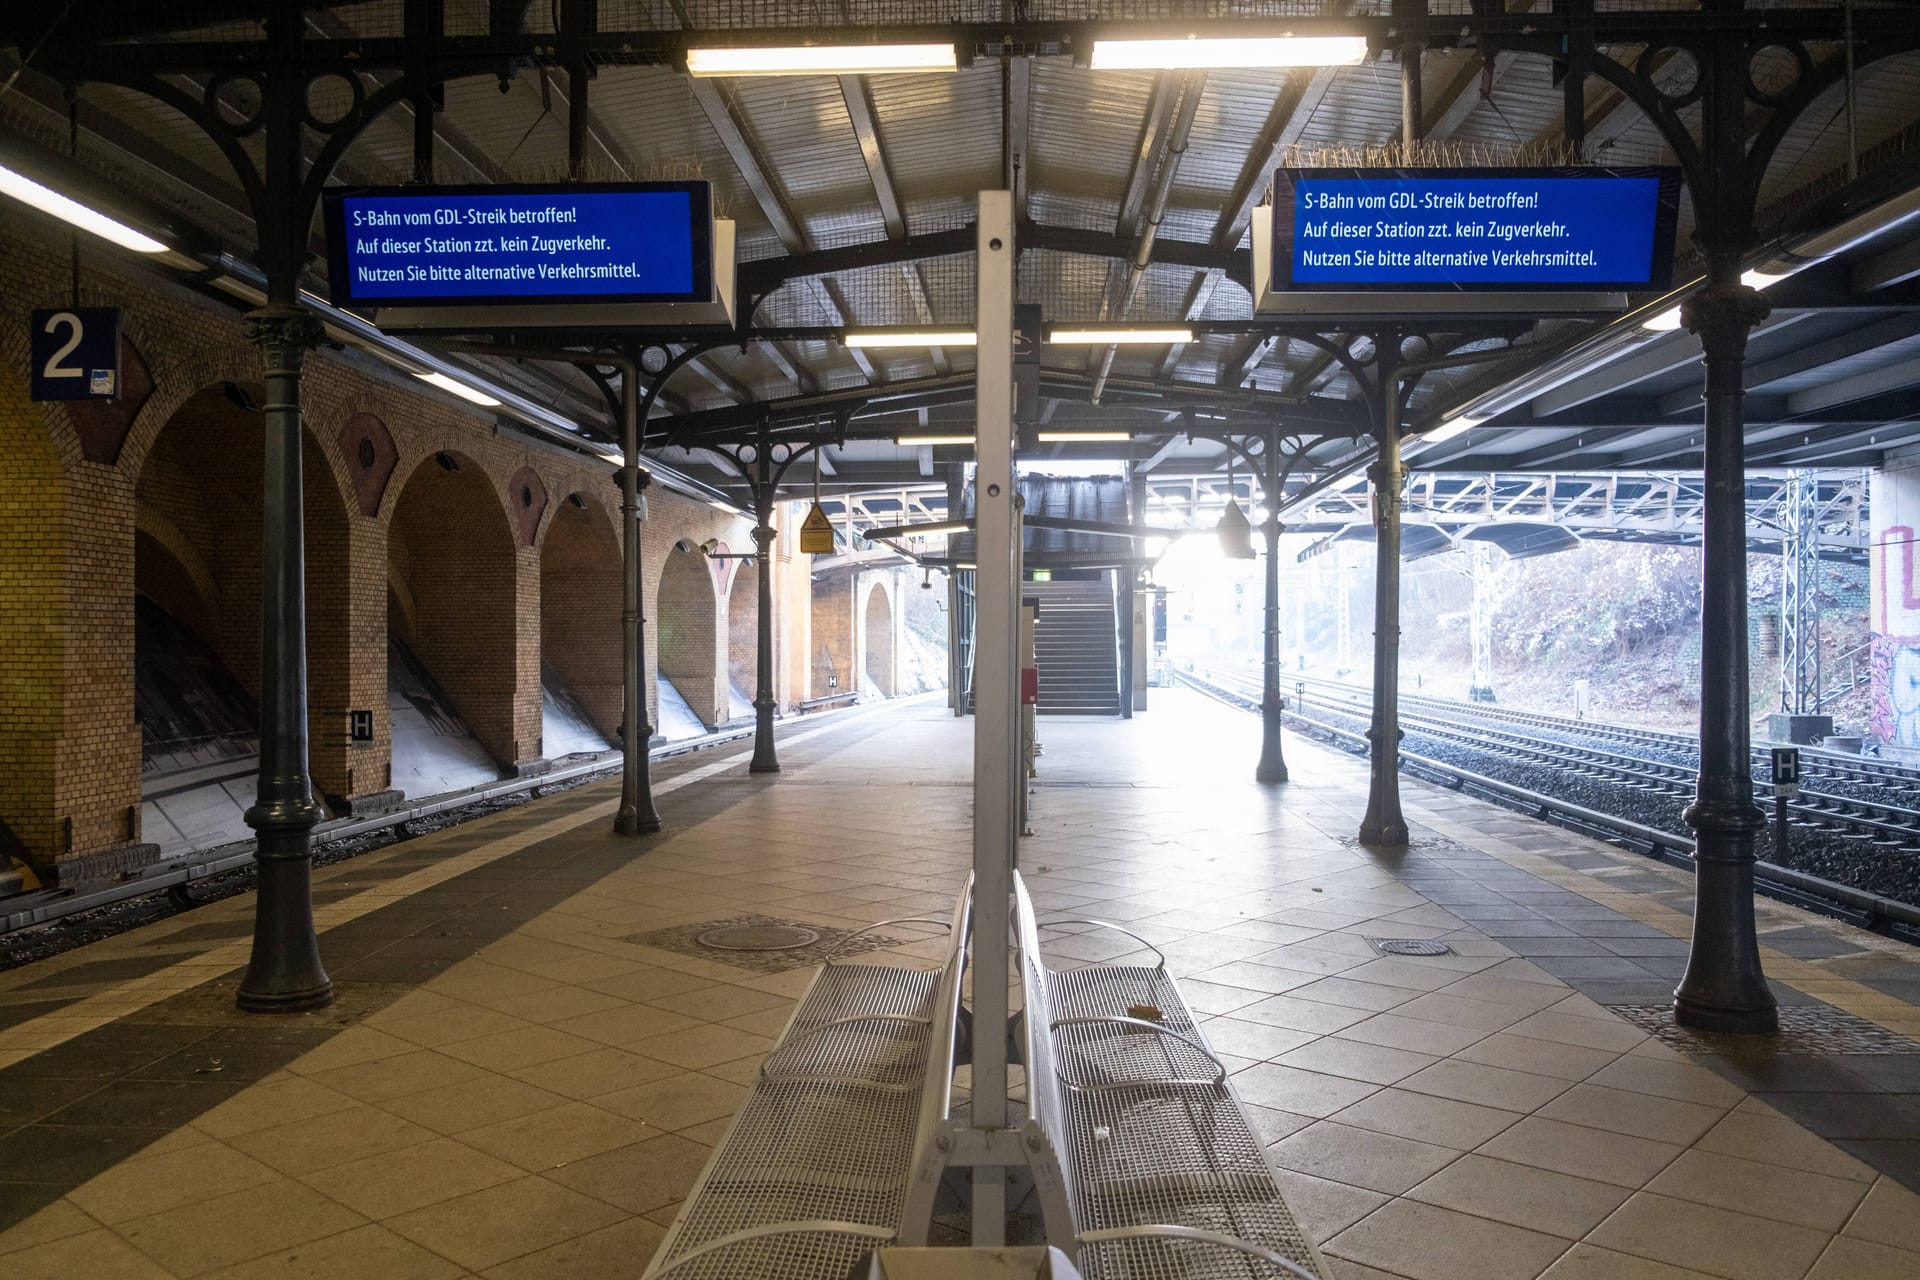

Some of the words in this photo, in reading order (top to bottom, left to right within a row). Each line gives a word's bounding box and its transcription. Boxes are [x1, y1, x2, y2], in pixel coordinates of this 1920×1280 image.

[1304, 192, 1354, 210] S-Bahn
[1357, 196, 1386, 209] vom
[1389, 191, 1466, 209] GDL-Streik
[1468, 191, 1539, 209] betroffen!
[353, 210, 401, 227] S-Bahn
[403, 213, 432, 226] vom
[434, 208, 507, 225] GDL-Streik
[509, 206, 577, 224] betroffen!
[1303, 220, 1329, 238] Auf
[1330, 221, 1373, 238] dieser
[1375, 220, 1425, 238] Station
[1427, 223, 1452, 238] zzt.
[1455, 220, 1484, 238] kein
[1487, 220, 1570, 241] Zugverkehr.
[356, 238, 379, 254] Auf
[381, 238, 422, 254] dieser
[424, 237, 472, 254] Station
[474, 238, 498, 253] zzt.
[500, 236, 529, 252] kein
[531, 234, 611, 254] Zugverkehr.
[1303, 249, 1351, 267] Nutzen
[1353, 249, 1375, 267] Sie
[1377, 249, 1411, 267] bitte
[1413, 249, 1489, 267] alternative
[1491, 249, 1598, 266] Verkehrsmittel.
[358, 266, 405, 282] Nutzen
[406, 265, 427, 282] Sie
[429, 265, 462, 281] bitte
[464, 264, 536, 281] alternative
[537, 262, 641, 279] Verkehrsmittel.
[43, 312, 84, 378] 2
[354, 714, 369, 736] H
[1777, 752, 1795, 778] H
